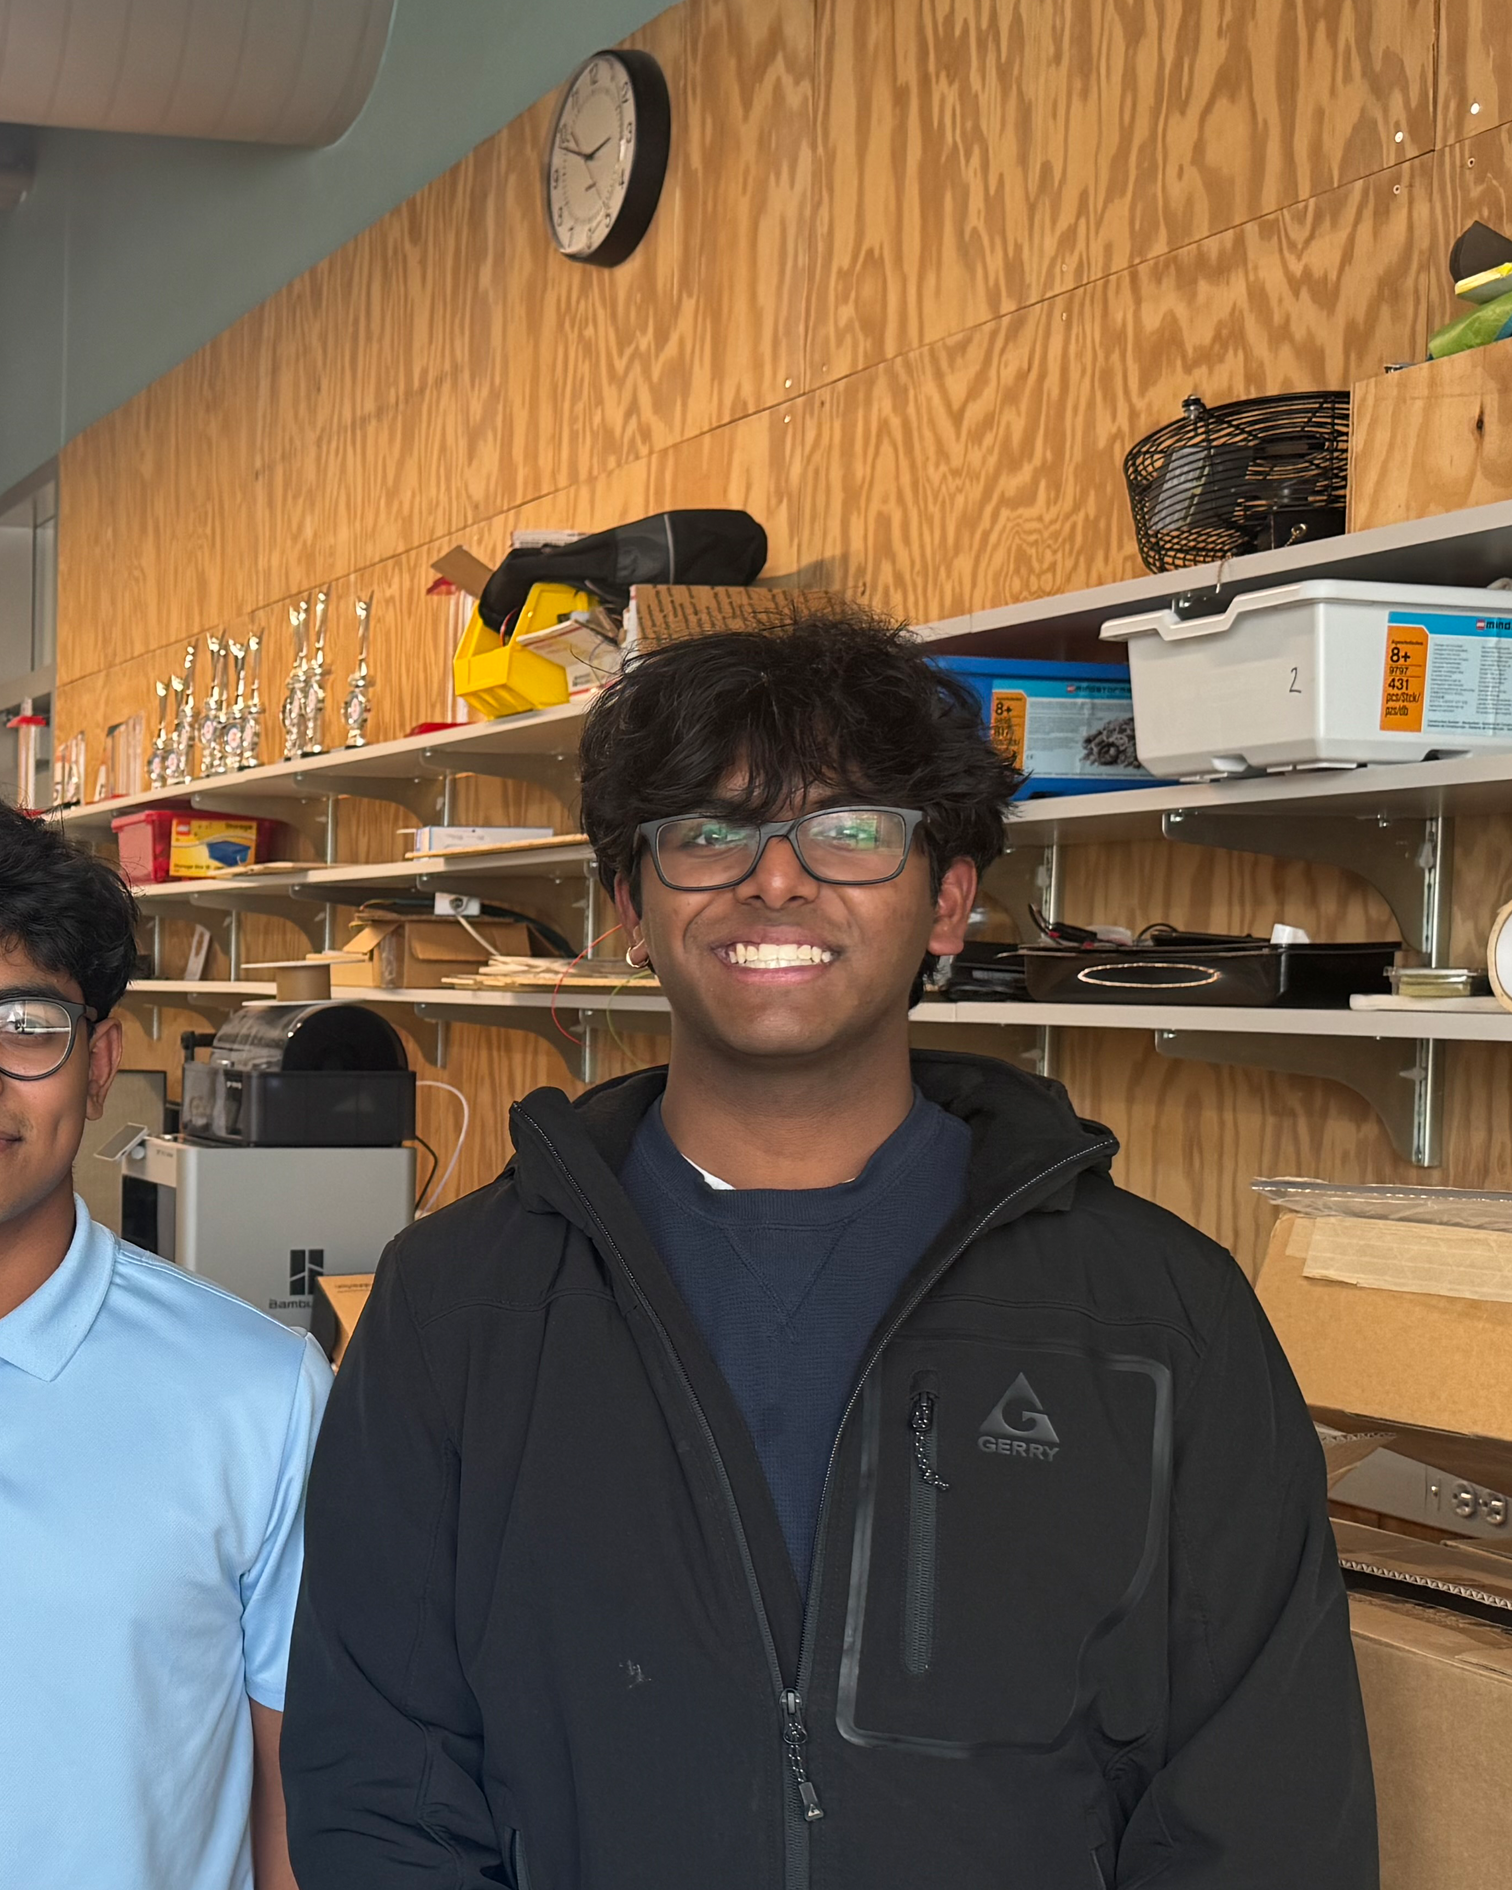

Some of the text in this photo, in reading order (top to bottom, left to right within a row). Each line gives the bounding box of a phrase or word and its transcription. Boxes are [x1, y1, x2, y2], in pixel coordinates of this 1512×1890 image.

[1486, 620, 1512, 631] mind
[1390, 646, 1411, 663] 8+
[1389, 666, 1409, 675] 9797
[1289, 666, 1302, 694] 2
[1388, 677, 1409, 691] 431
[995, 701, 1013, 716] 8+
[978, 1436, 1060, 1462] GERRY
